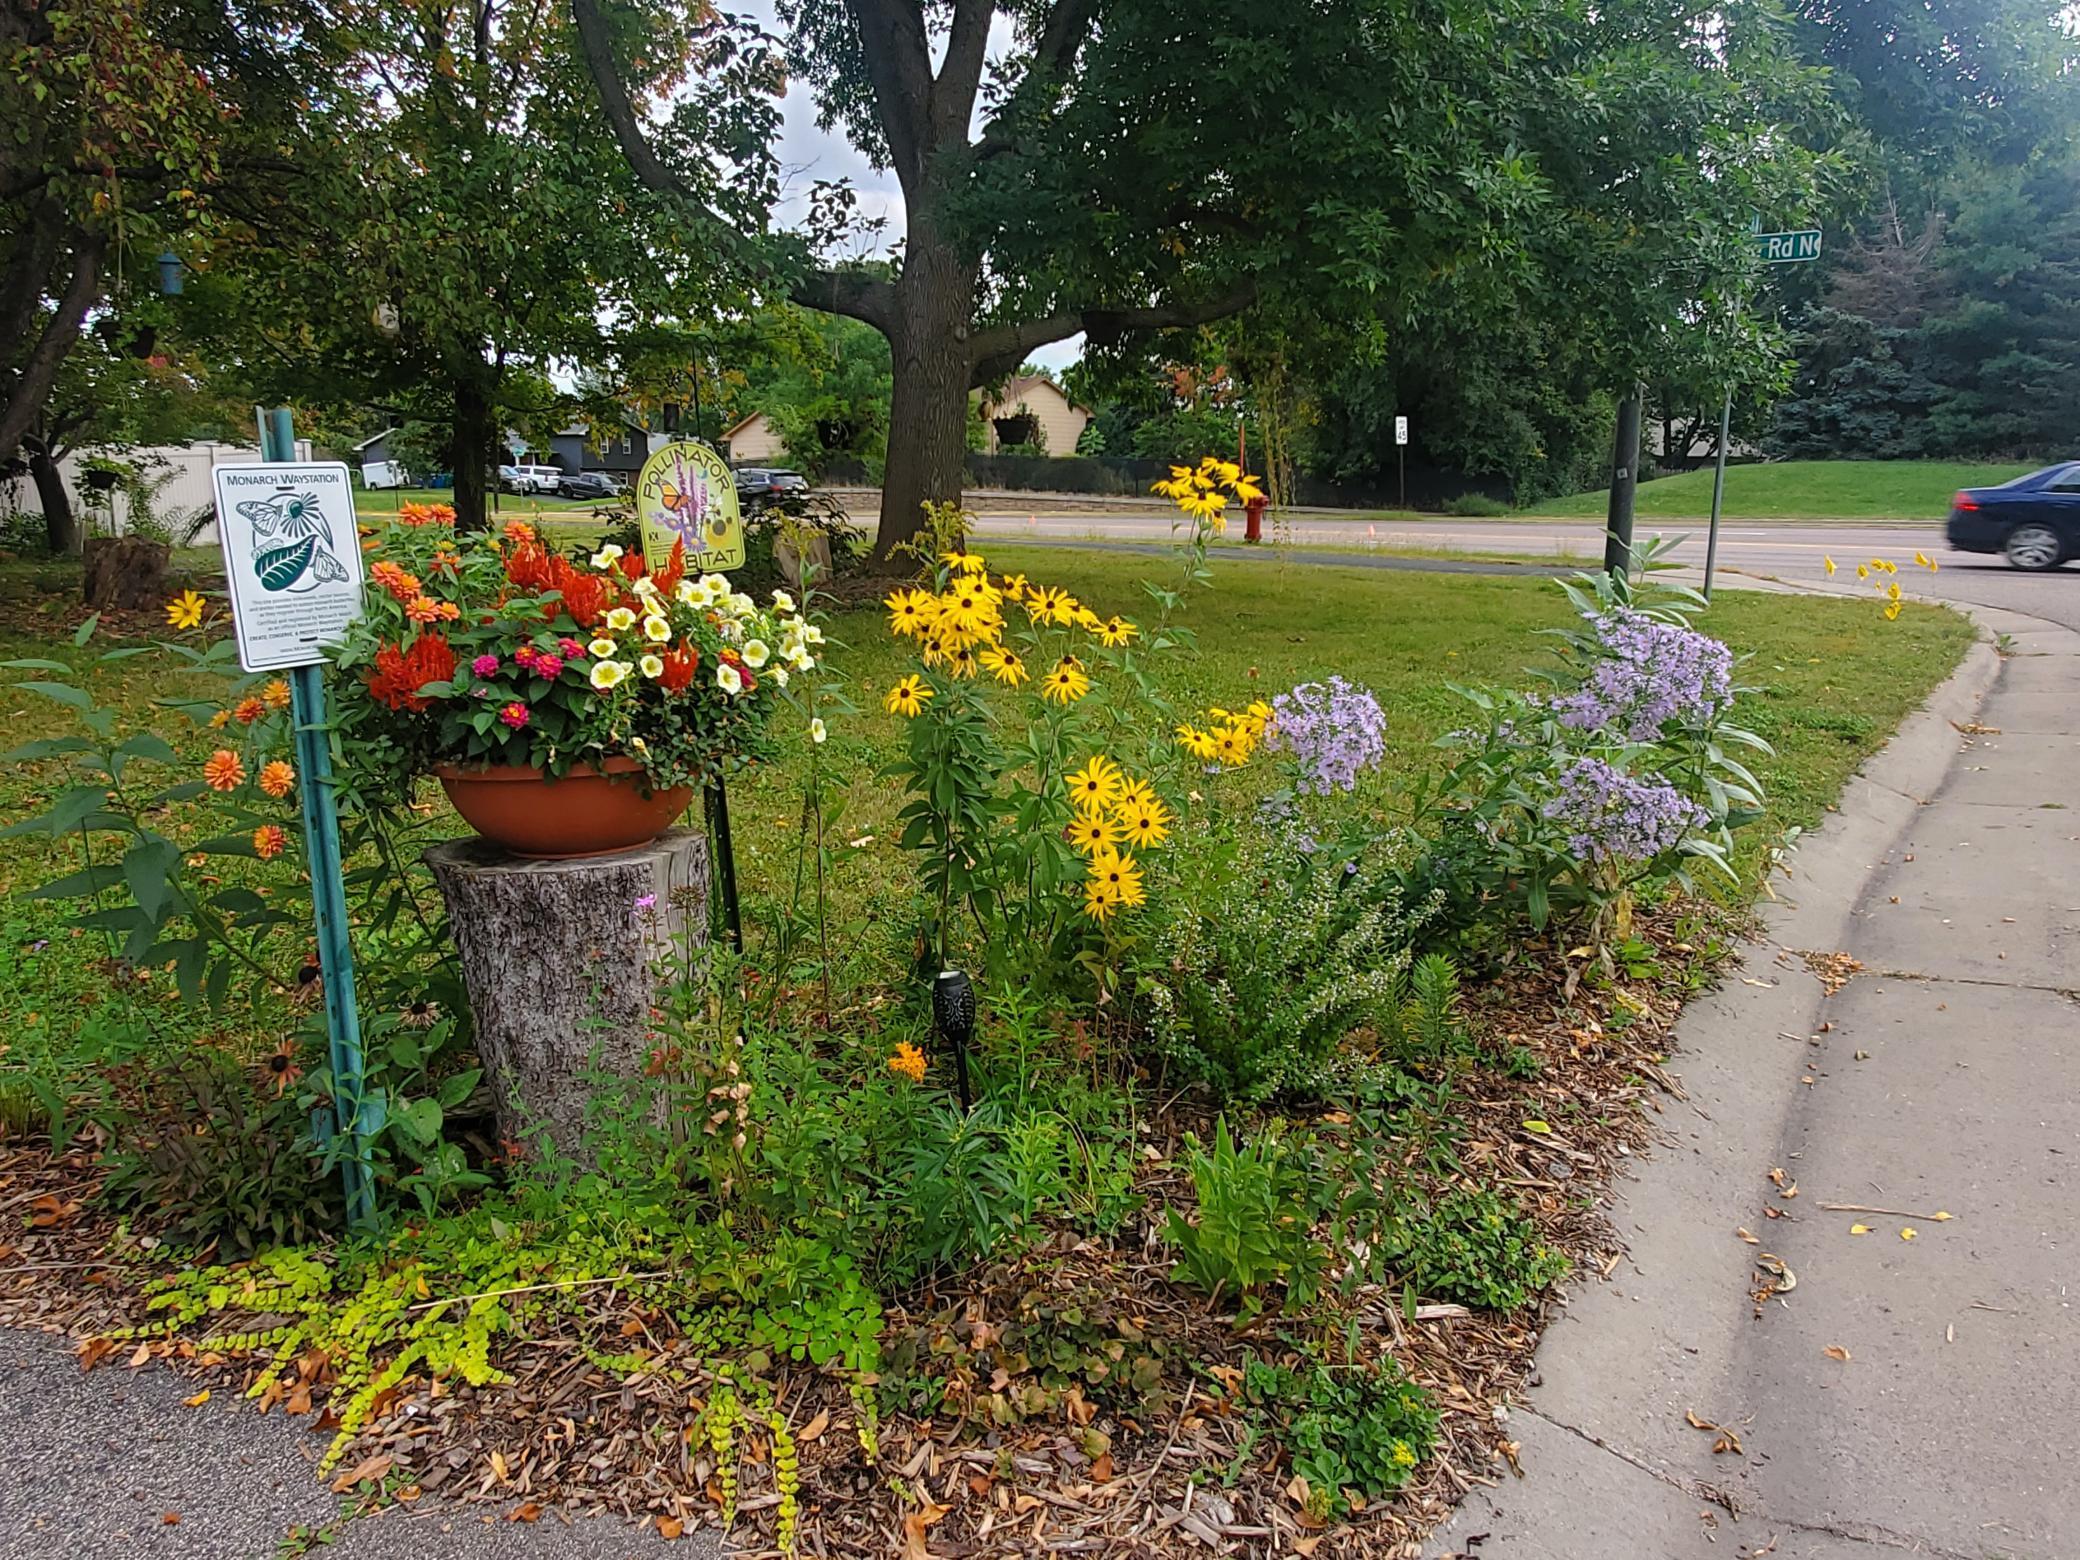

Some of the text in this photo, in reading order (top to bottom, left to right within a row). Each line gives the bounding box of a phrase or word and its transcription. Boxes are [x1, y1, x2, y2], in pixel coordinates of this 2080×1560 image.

[1768, 235, 1814, 259] Rd N
[226, 474, 339, 486] MONARCH WAYSTATION
[643, 447, 730, 500] POLLINATOR
[653, 548, 737, 570] HBITAT
